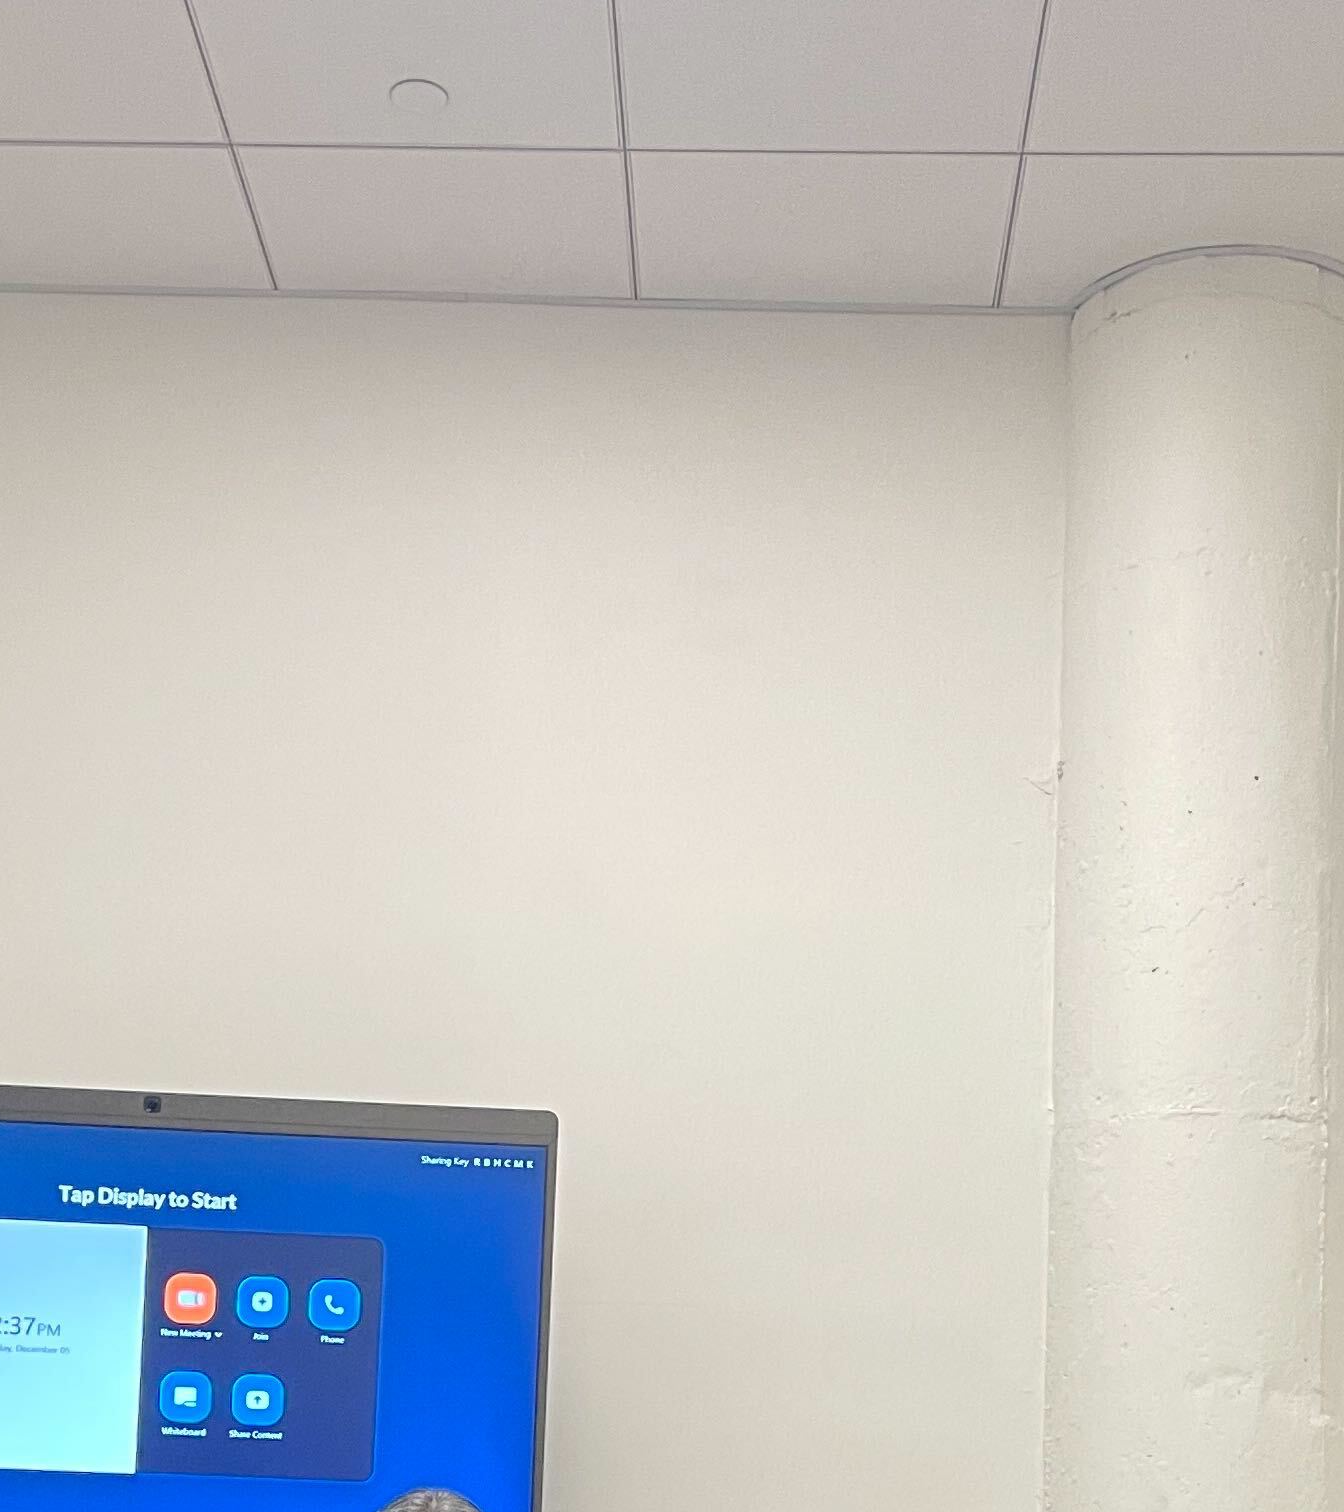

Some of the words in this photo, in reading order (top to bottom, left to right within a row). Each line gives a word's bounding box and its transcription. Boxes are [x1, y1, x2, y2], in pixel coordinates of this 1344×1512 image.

[421, 1155, 453, 1168] Sharing
[453, 1157, 470, 1168] Key
[58, 1184, 95, 1207] Tap
[97, 1185, 167, 1210] Display
[167, 1190, 190, 1209] to
[191, 1191, 238, 1211] Start
[179, 1328, 213, 1341] Meeting
[252, 1332, 270, 1342] Join
[319, 1334, 346, 1345] Phone
[160, 1426, 208, 1437] Whiteboard
[228, 1429, 251, 1438] Share
[251, 1430, 284, 1440] Content
